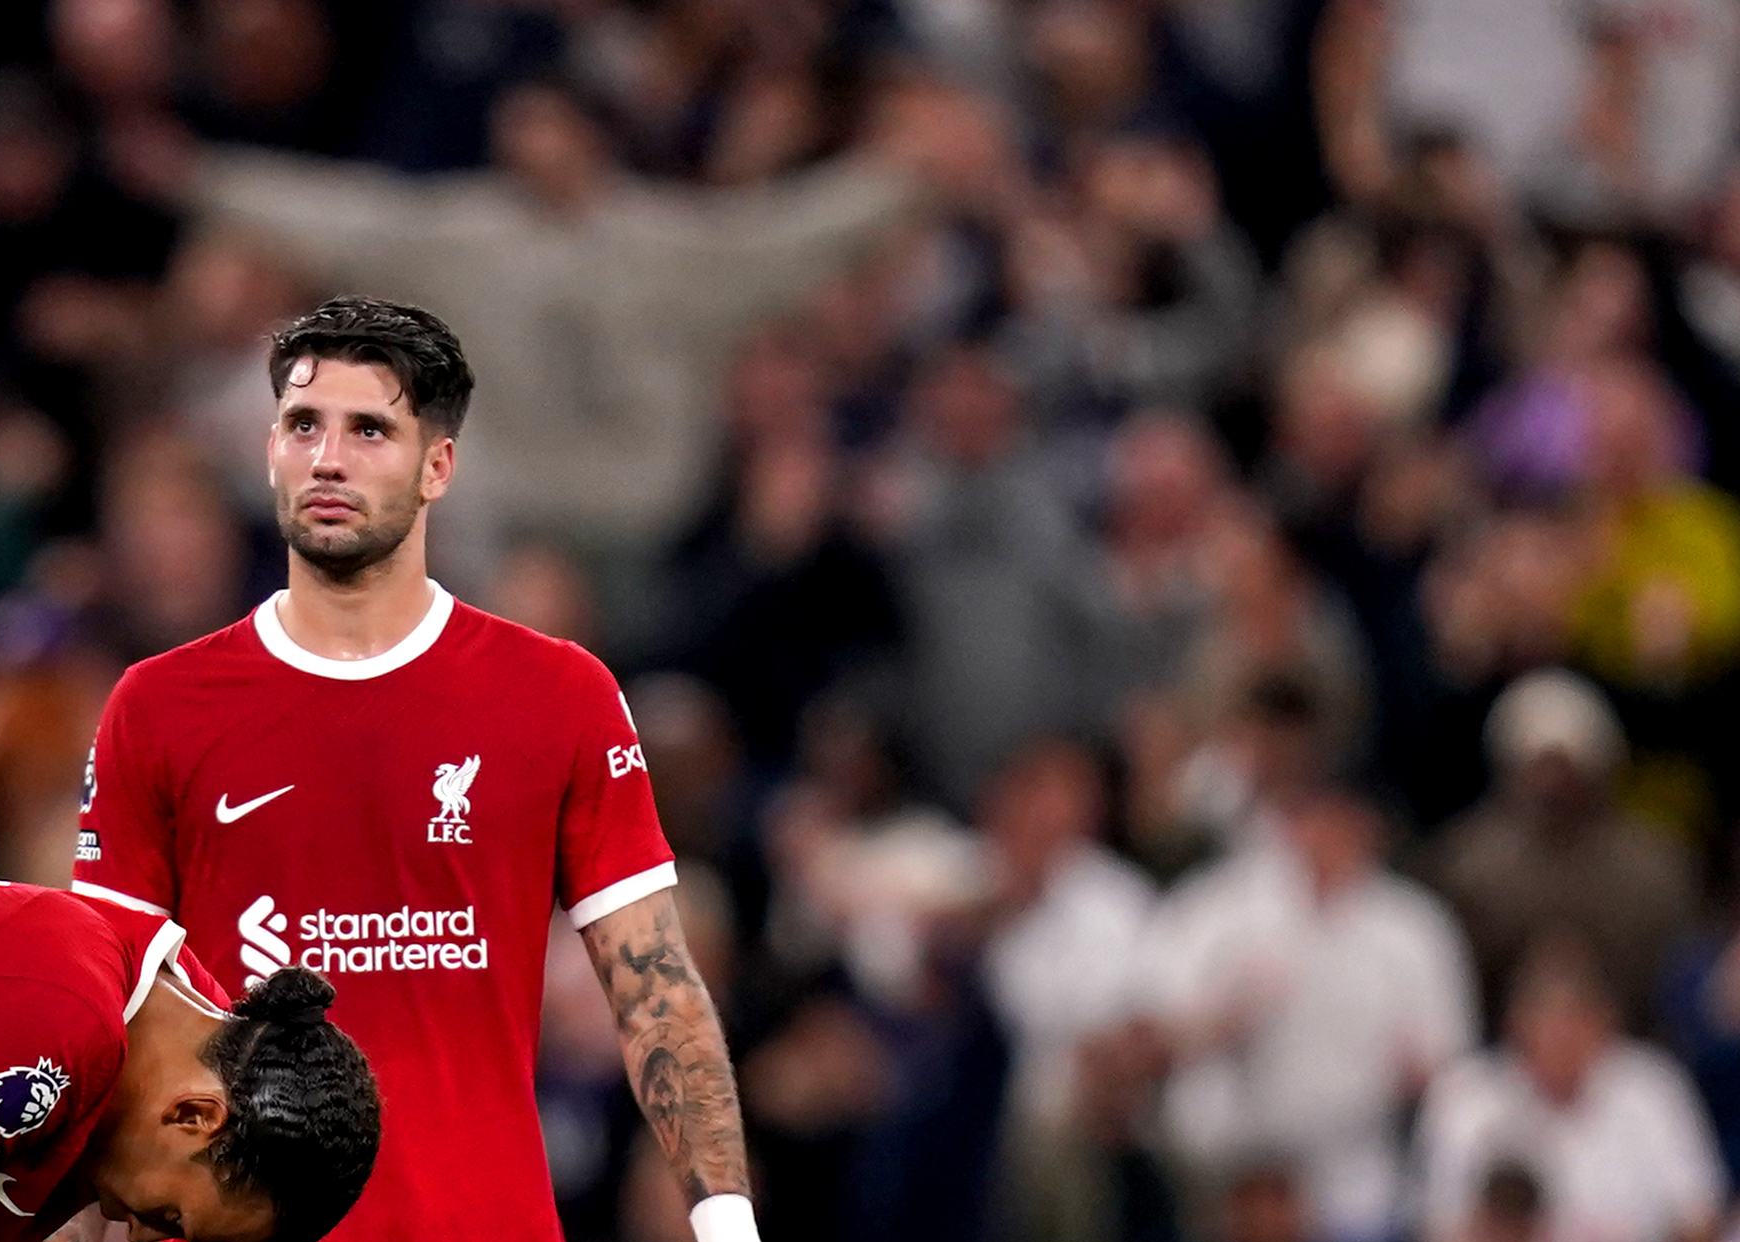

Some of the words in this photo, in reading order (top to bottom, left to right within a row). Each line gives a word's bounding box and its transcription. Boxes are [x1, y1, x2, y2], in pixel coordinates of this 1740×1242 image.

[606, 743, 648, 778] Ex
[299, 904, 475, 941] standard
[300, 937, 489, 973] chartered
